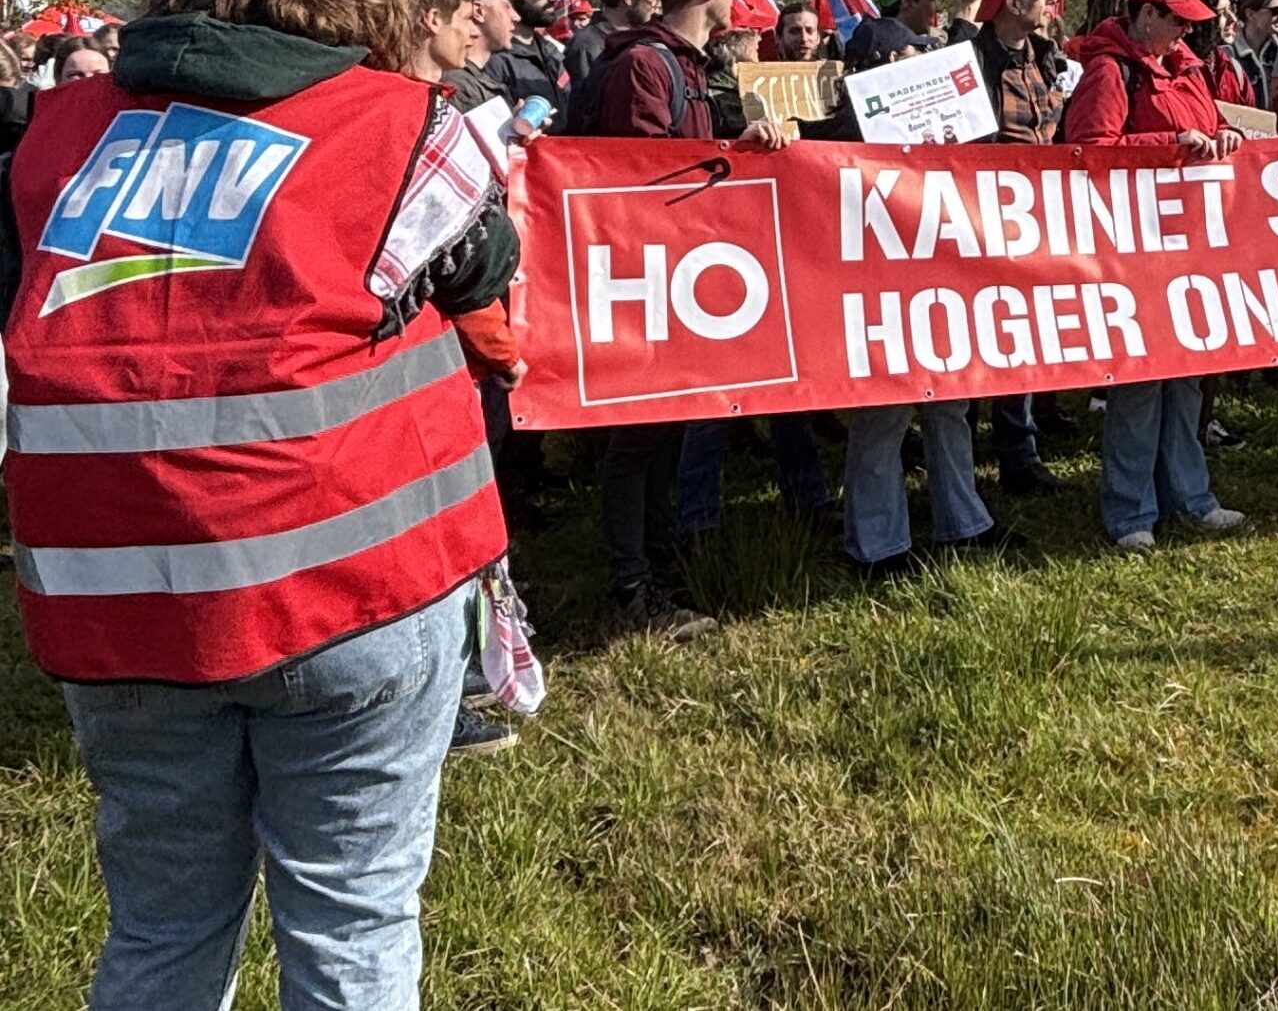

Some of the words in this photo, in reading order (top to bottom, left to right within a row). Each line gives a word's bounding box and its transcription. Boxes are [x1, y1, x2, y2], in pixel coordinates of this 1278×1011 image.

[753, 75, 839, 126] SCIENCE
[61, 138, 295, 220] FNV
[838, 164, 1234, 262] KABINET
[587, 241, 769, 342] HO
[843, 282, 1147, 378] HOGER
